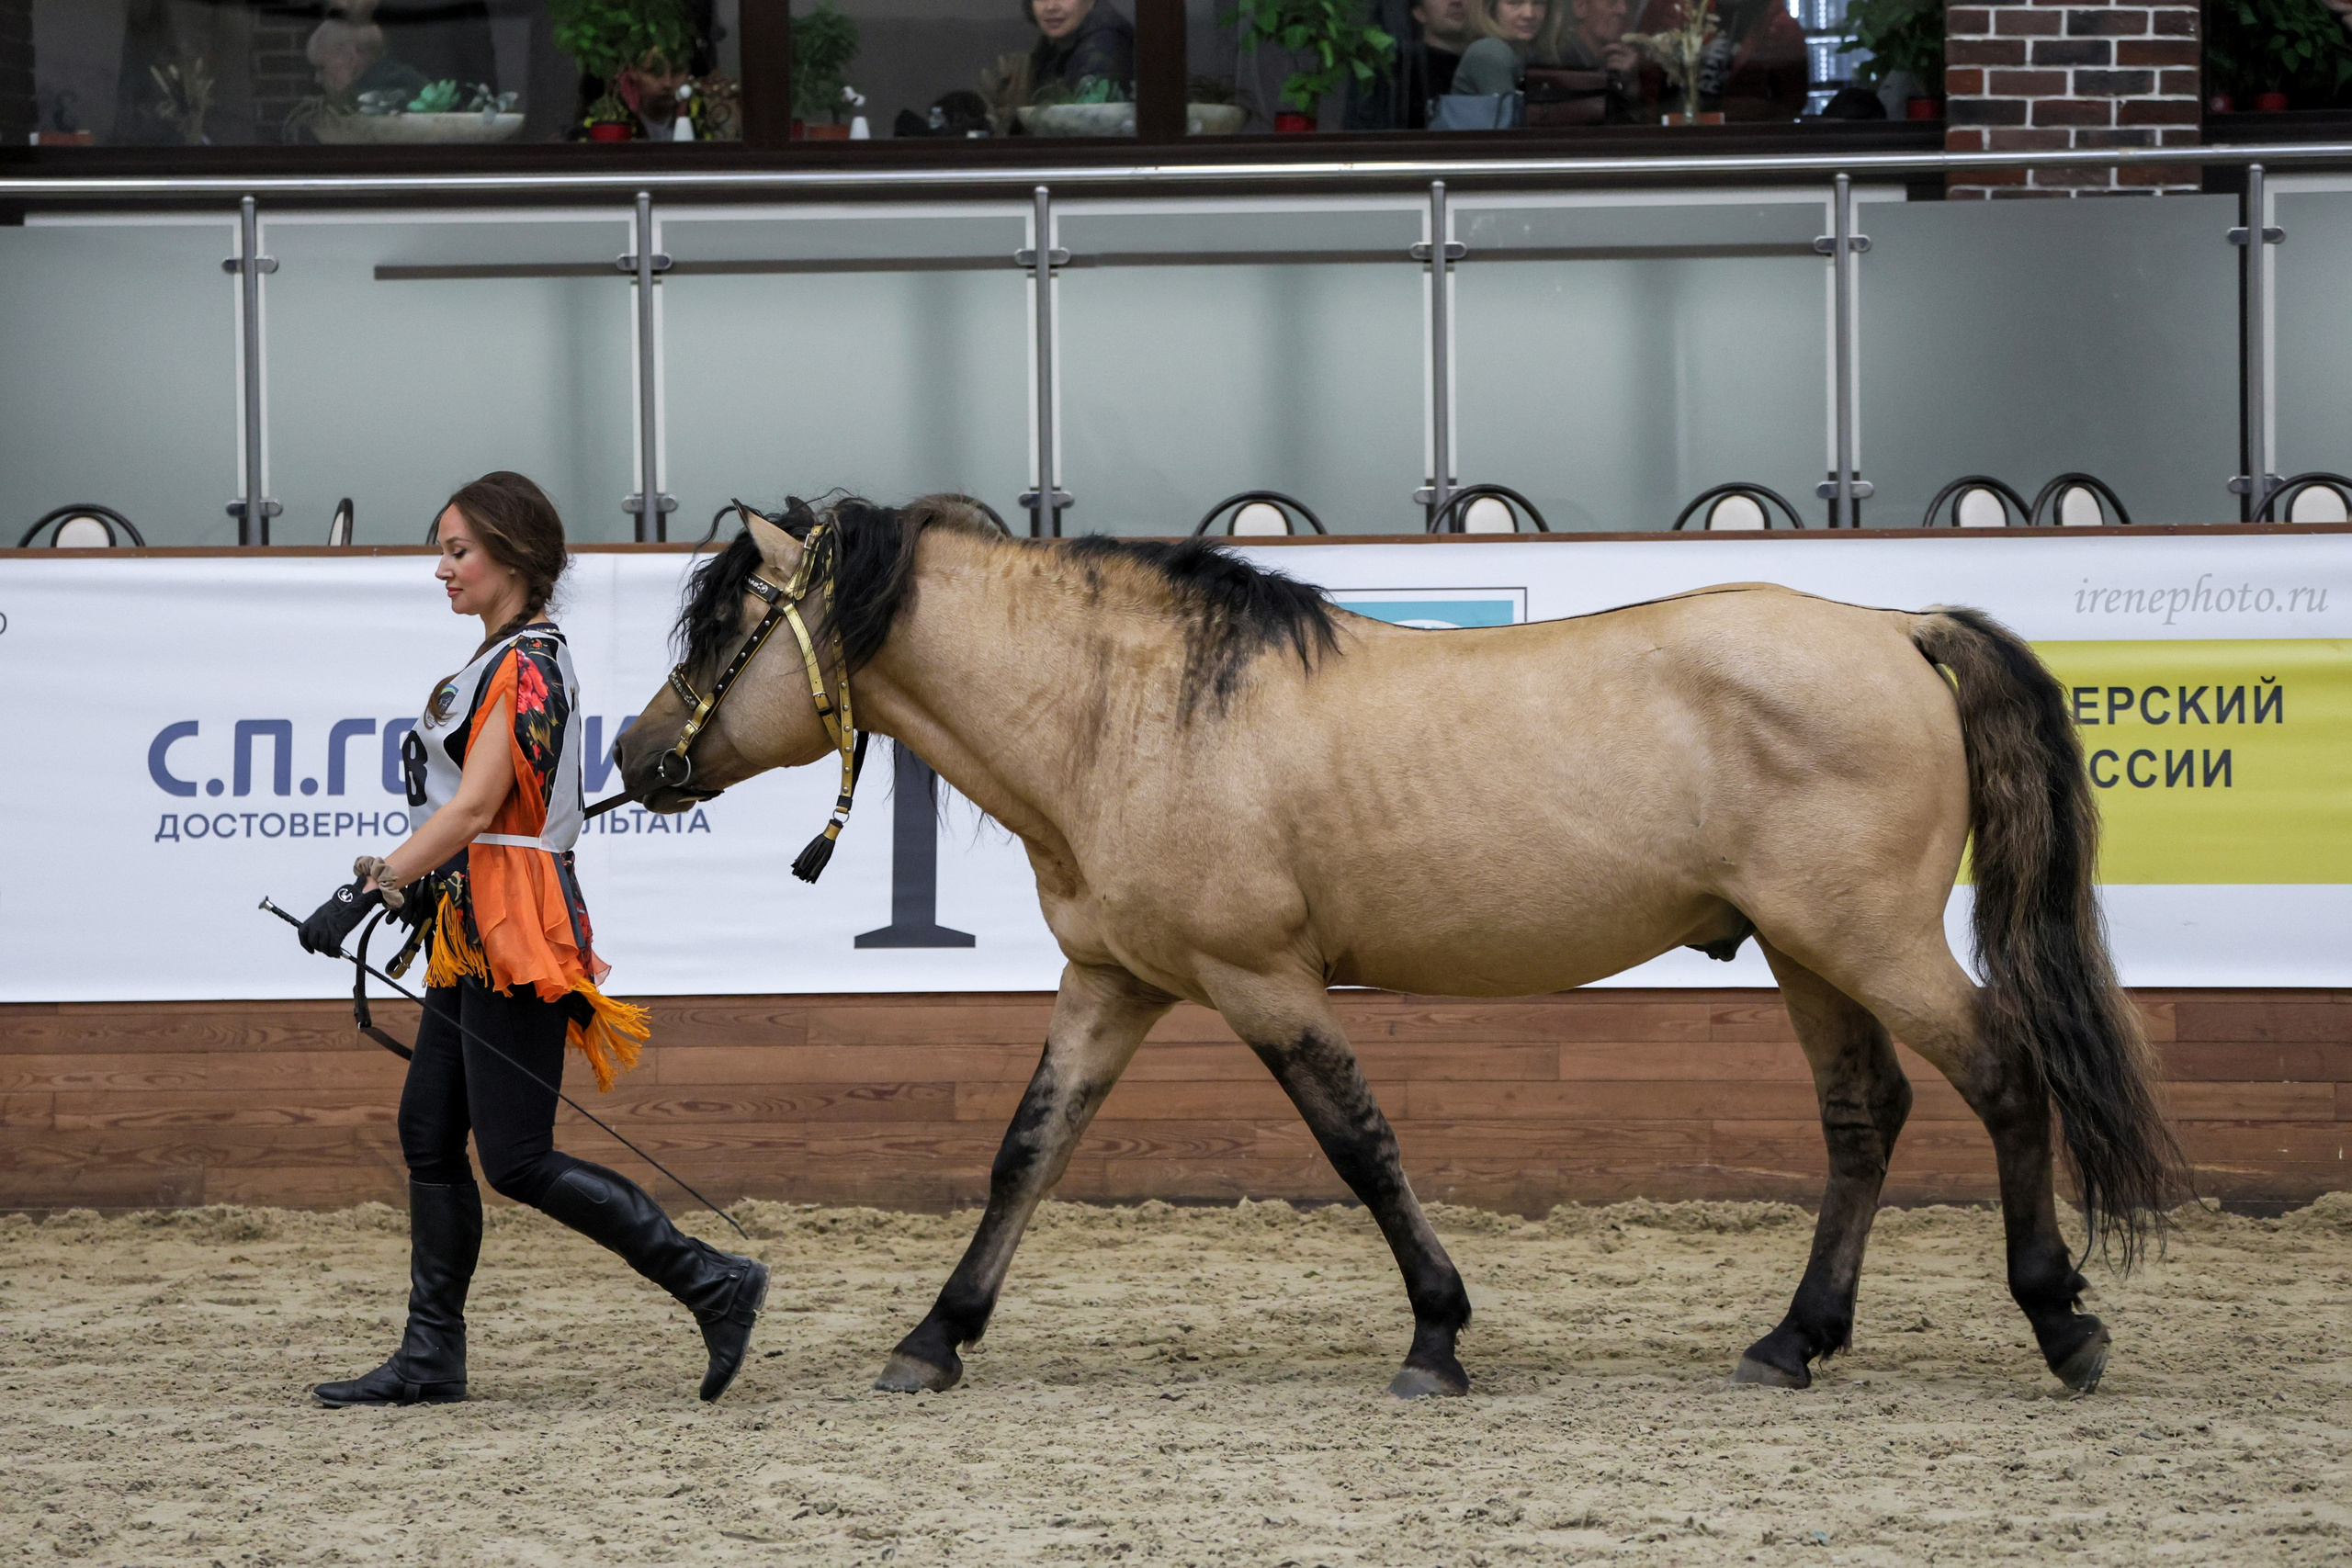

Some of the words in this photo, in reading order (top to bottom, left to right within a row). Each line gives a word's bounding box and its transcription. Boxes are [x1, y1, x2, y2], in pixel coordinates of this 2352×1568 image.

[2073, 675, 2284, 725] ЕРСКИЙ
[2089, 749, 2233, 788] ССИИ
[154, 811, 410, 842] ДОСТОВЕРНО
[582, 808, 712, 834] ЛЬТАТА
